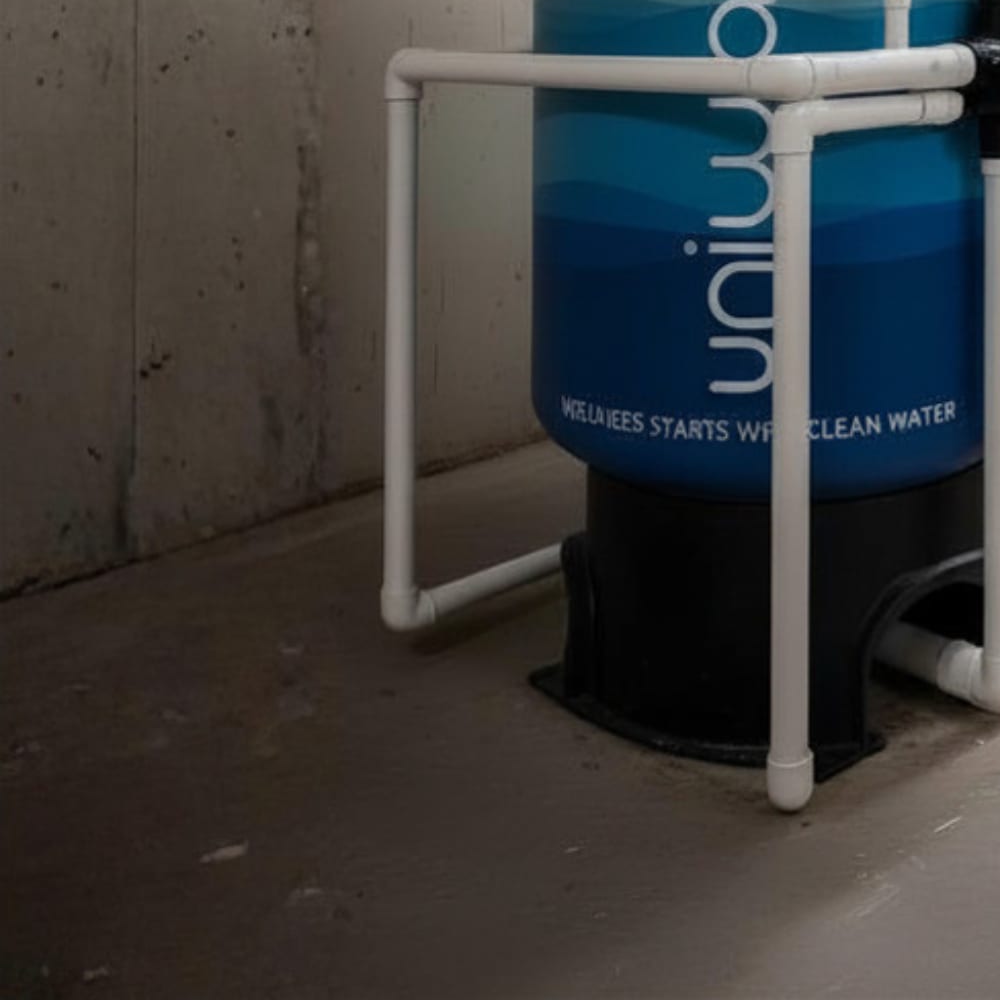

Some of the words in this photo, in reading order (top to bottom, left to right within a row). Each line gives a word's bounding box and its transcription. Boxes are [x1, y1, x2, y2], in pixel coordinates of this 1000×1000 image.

[649, 415, 729, 442] STARTS
[807, 414, 881, 440] CLEAN
[887, 400, 957, 433] WATER
